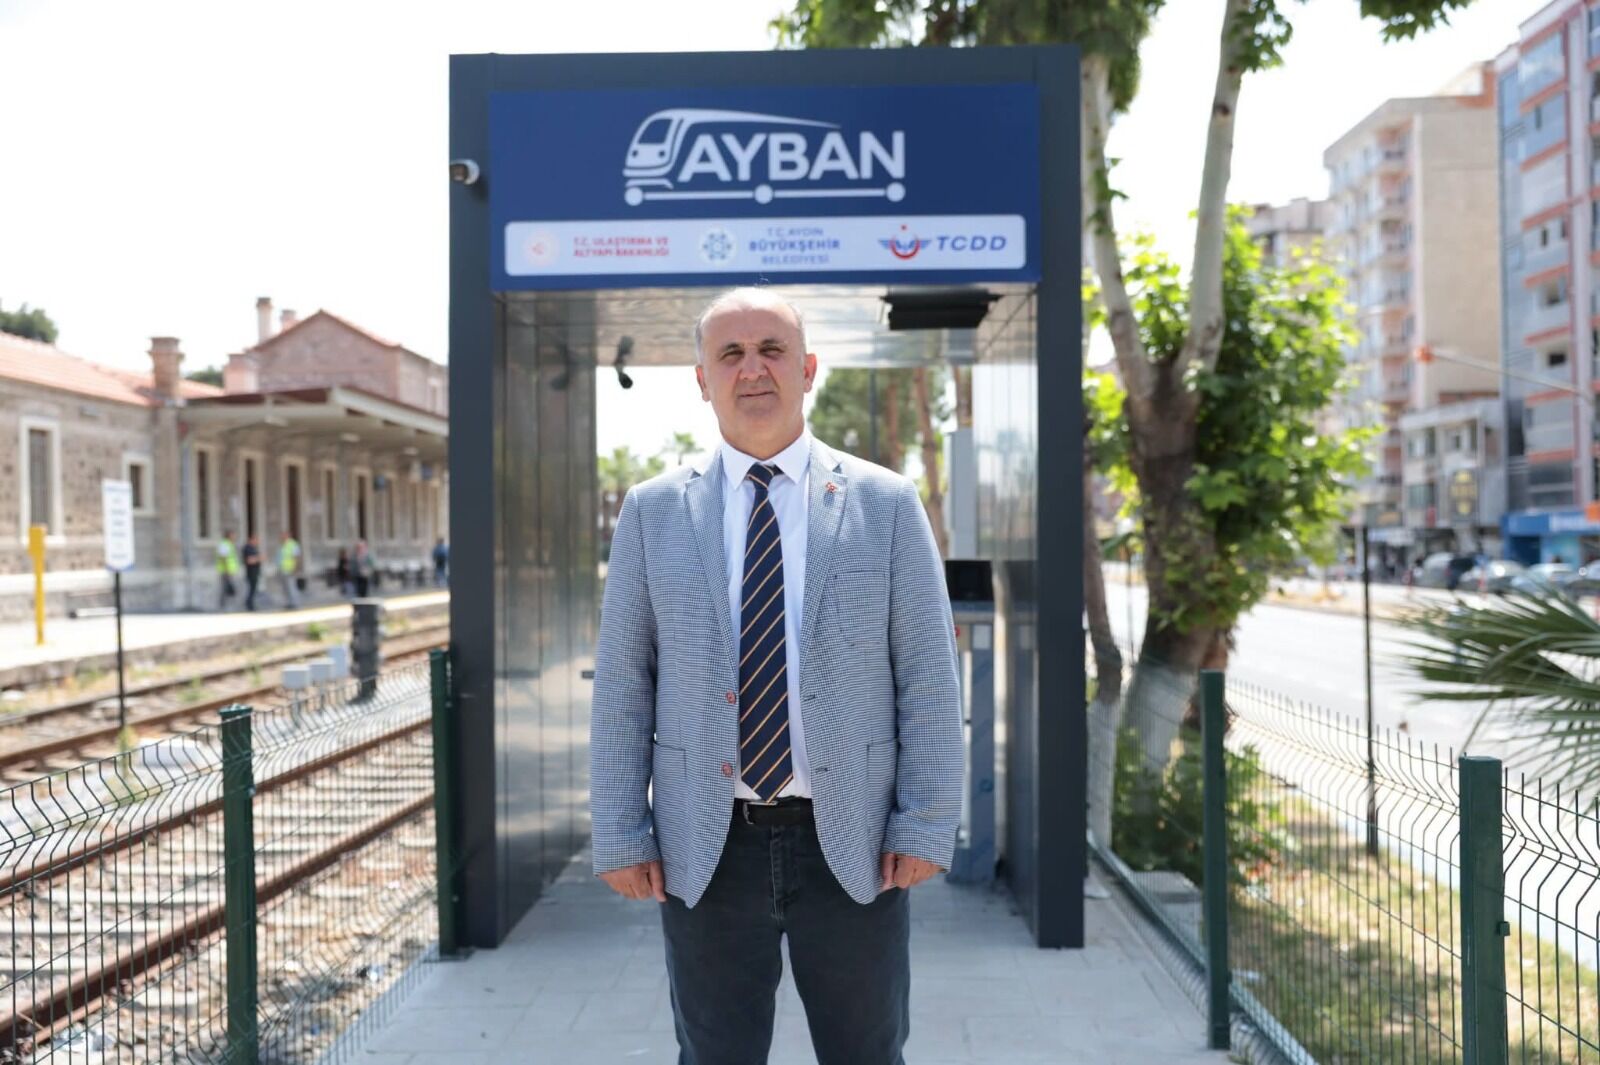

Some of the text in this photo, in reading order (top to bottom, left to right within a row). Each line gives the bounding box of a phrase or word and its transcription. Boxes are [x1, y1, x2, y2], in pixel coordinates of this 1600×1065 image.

[677, 131, 905, 182] AYBAN
[749, 238, 840, 252] BÜYÜKŞEHİR
[936, 235, 1007, 251] TCDD
